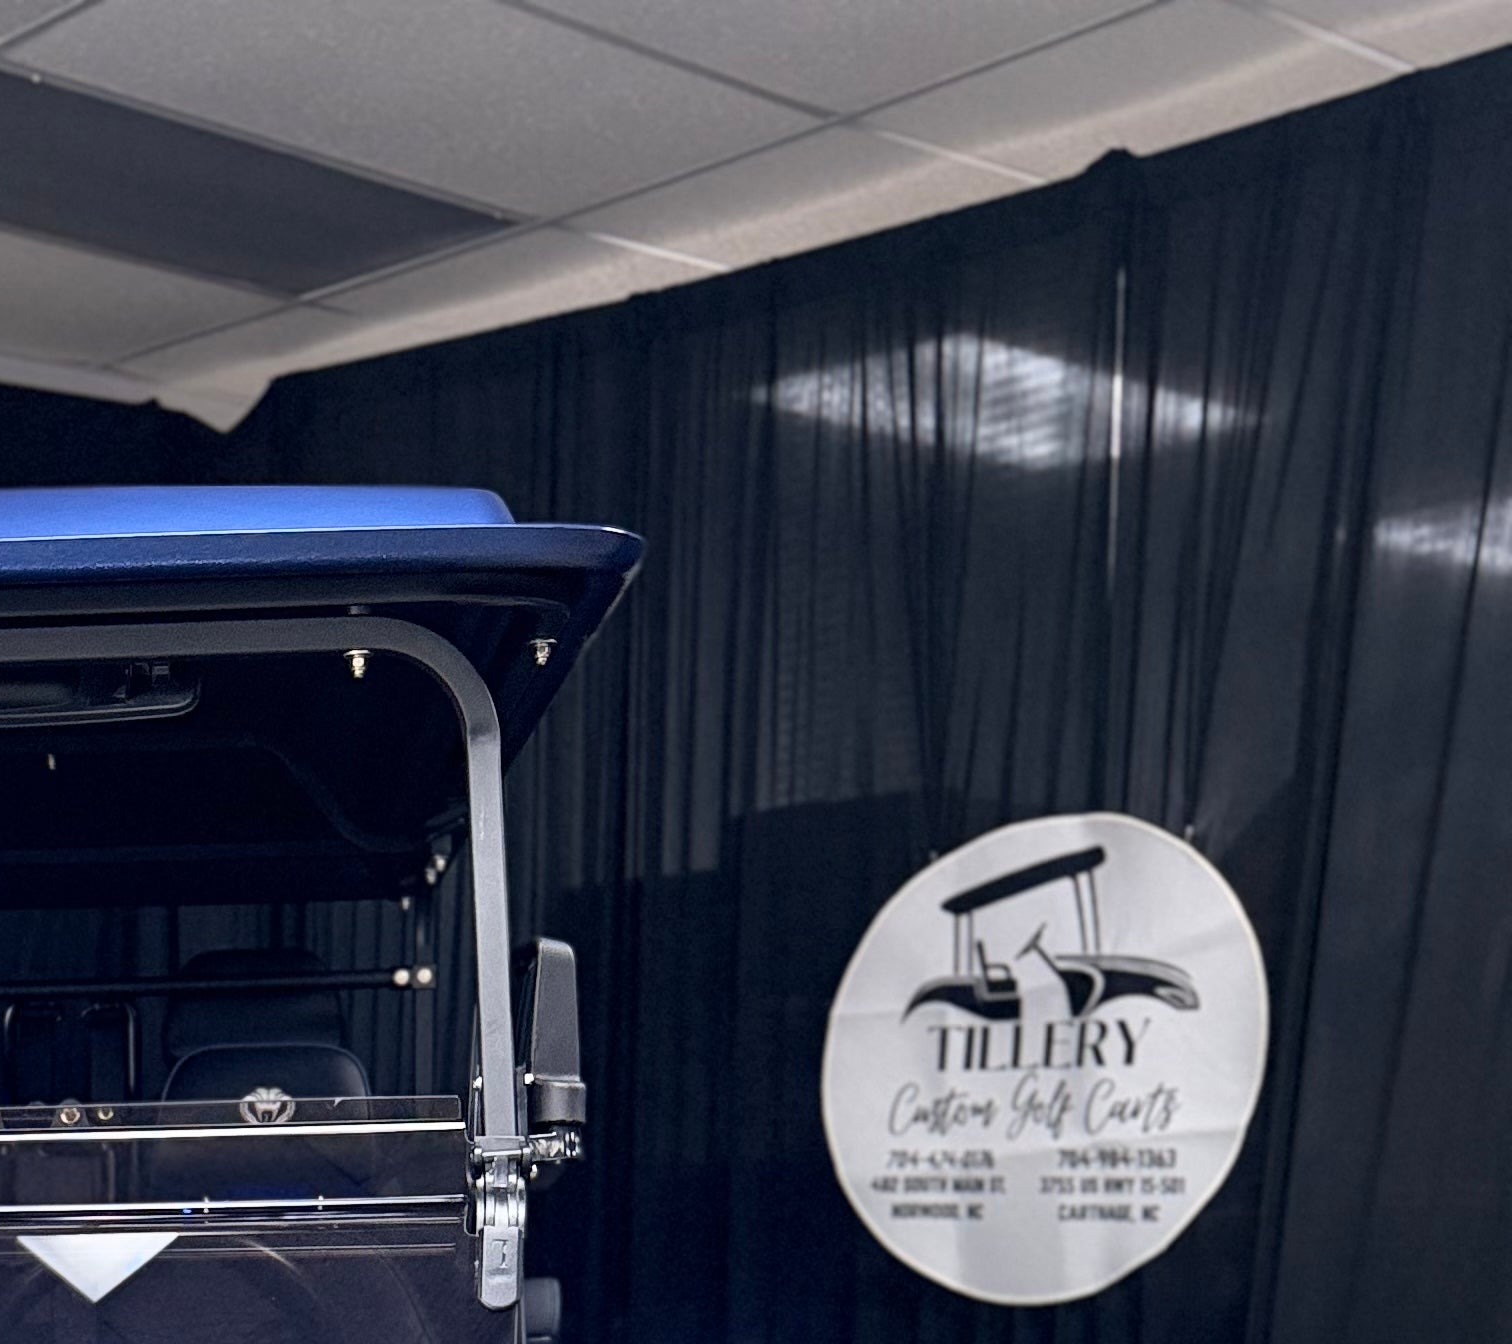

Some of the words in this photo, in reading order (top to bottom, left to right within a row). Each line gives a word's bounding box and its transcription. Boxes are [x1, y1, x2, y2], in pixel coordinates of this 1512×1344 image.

[927, 1017, 1151, 1071] TILLERY
[889, 1081, 996, 1136] Custom
[1005, 1068, 1073, 1140] Golf
[1083, 1077, 1179, 1135] Carts
[1141, 1203, 1162, 1222] NC
